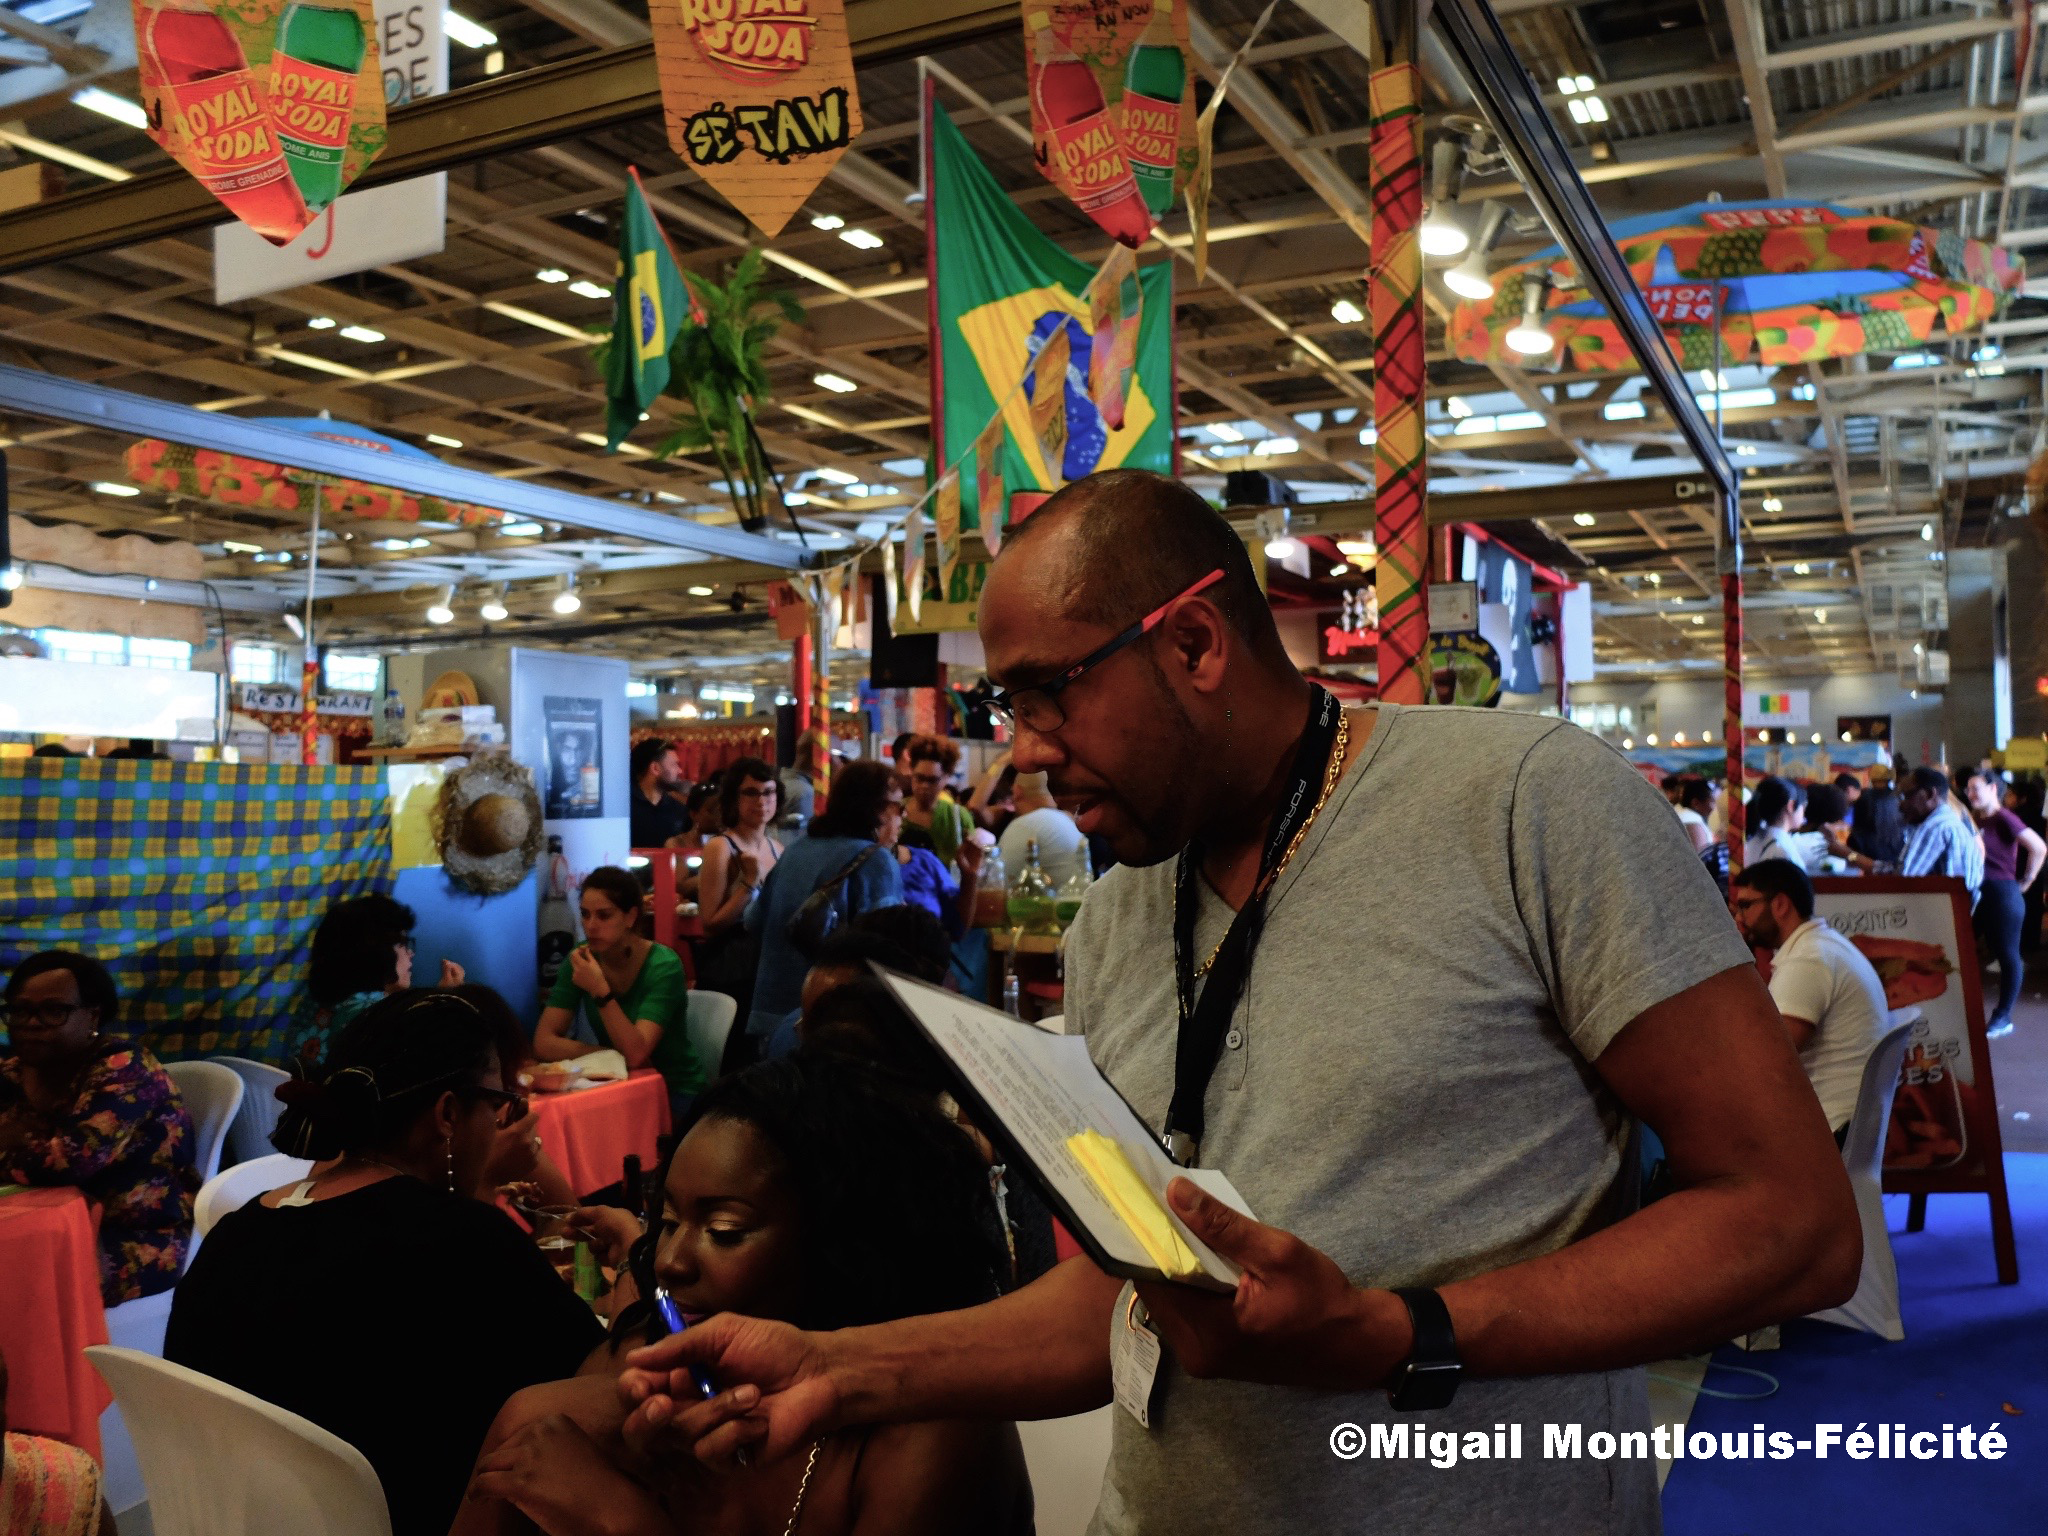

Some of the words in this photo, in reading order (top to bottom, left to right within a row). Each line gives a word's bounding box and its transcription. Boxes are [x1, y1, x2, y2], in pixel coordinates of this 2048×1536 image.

[376, 5, 425, 57] ES
[703, 20, 807, 63] SODA
[268, 72, 350, 106] ROYAL
[173, 85, 259, 146] ROYAL
[276, 99, 343, 140] SODA
[685, 103, 739, 162] SÉ
[735, 90, 847, 156] TAW
[1121, 109, 1176, 135] ROYAL
[194, 126, 272, 161] SODA
[1056, 124, 1115, 176] ROYAL
[1126, 131, 1172, 160] SODA
[236, 164, 284, 187] GRENADINE
[1071, 153, 1125, 185] SODA
[1826, 905, 1908, 935] OKITS
